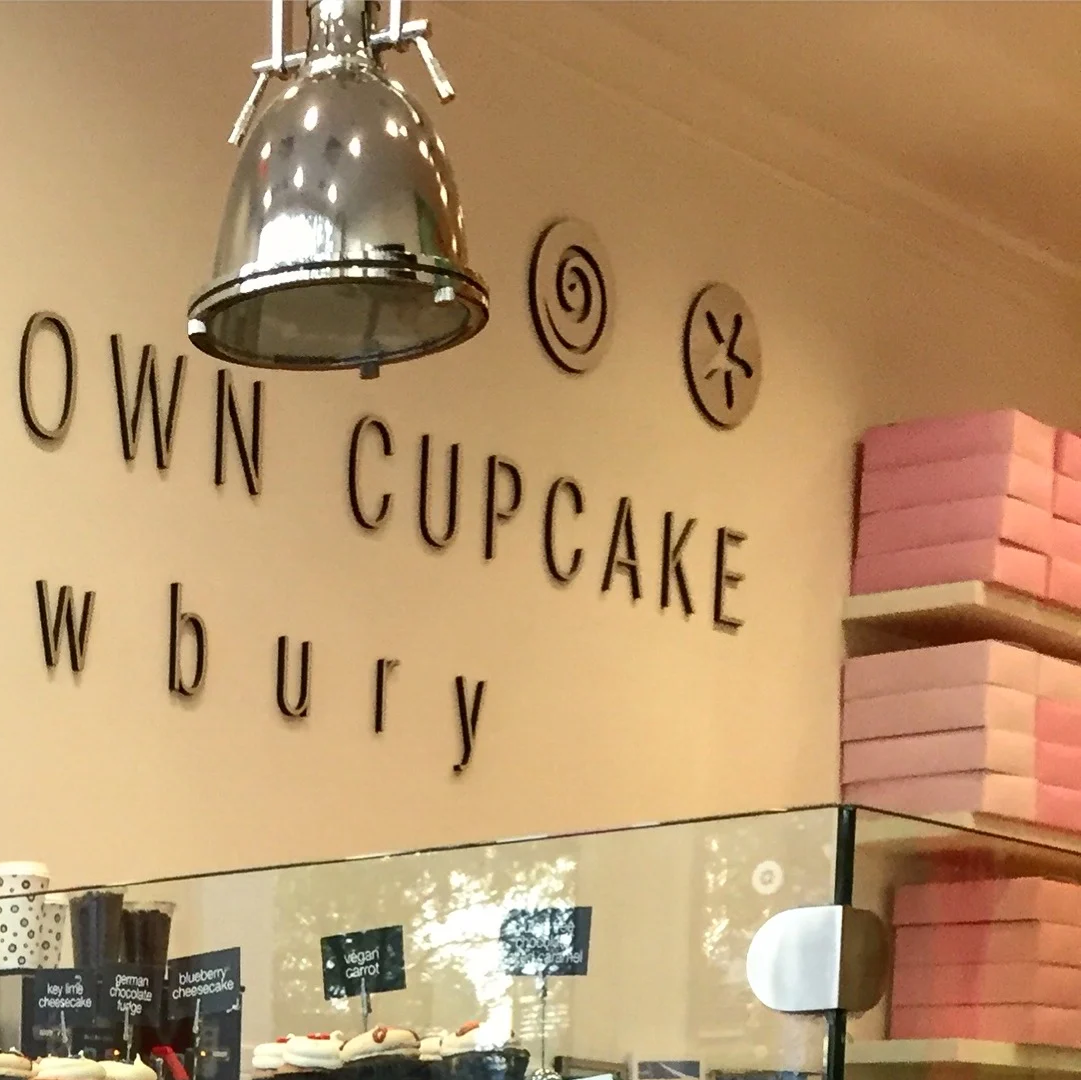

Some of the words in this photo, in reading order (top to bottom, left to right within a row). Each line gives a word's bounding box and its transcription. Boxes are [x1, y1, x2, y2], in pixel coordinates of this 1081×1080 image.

[349, 416, 748, 634] CUPCAKE
[343, 947, 380, 967] vegan
[178, 967, 229, 986] blueberry
[345, 962, 380, 979] carrot
[115, 974, 149, 988] german
[172, 978, 235, 1000] cheesecake
[47, 983, 63, 997] key
[65, 982, 84, 996] lime
[109, 986, 153, 1002] chocolate
[38, 996, 92, 1009] cheesecake
[117, 1000, 143, 1016] fudge
